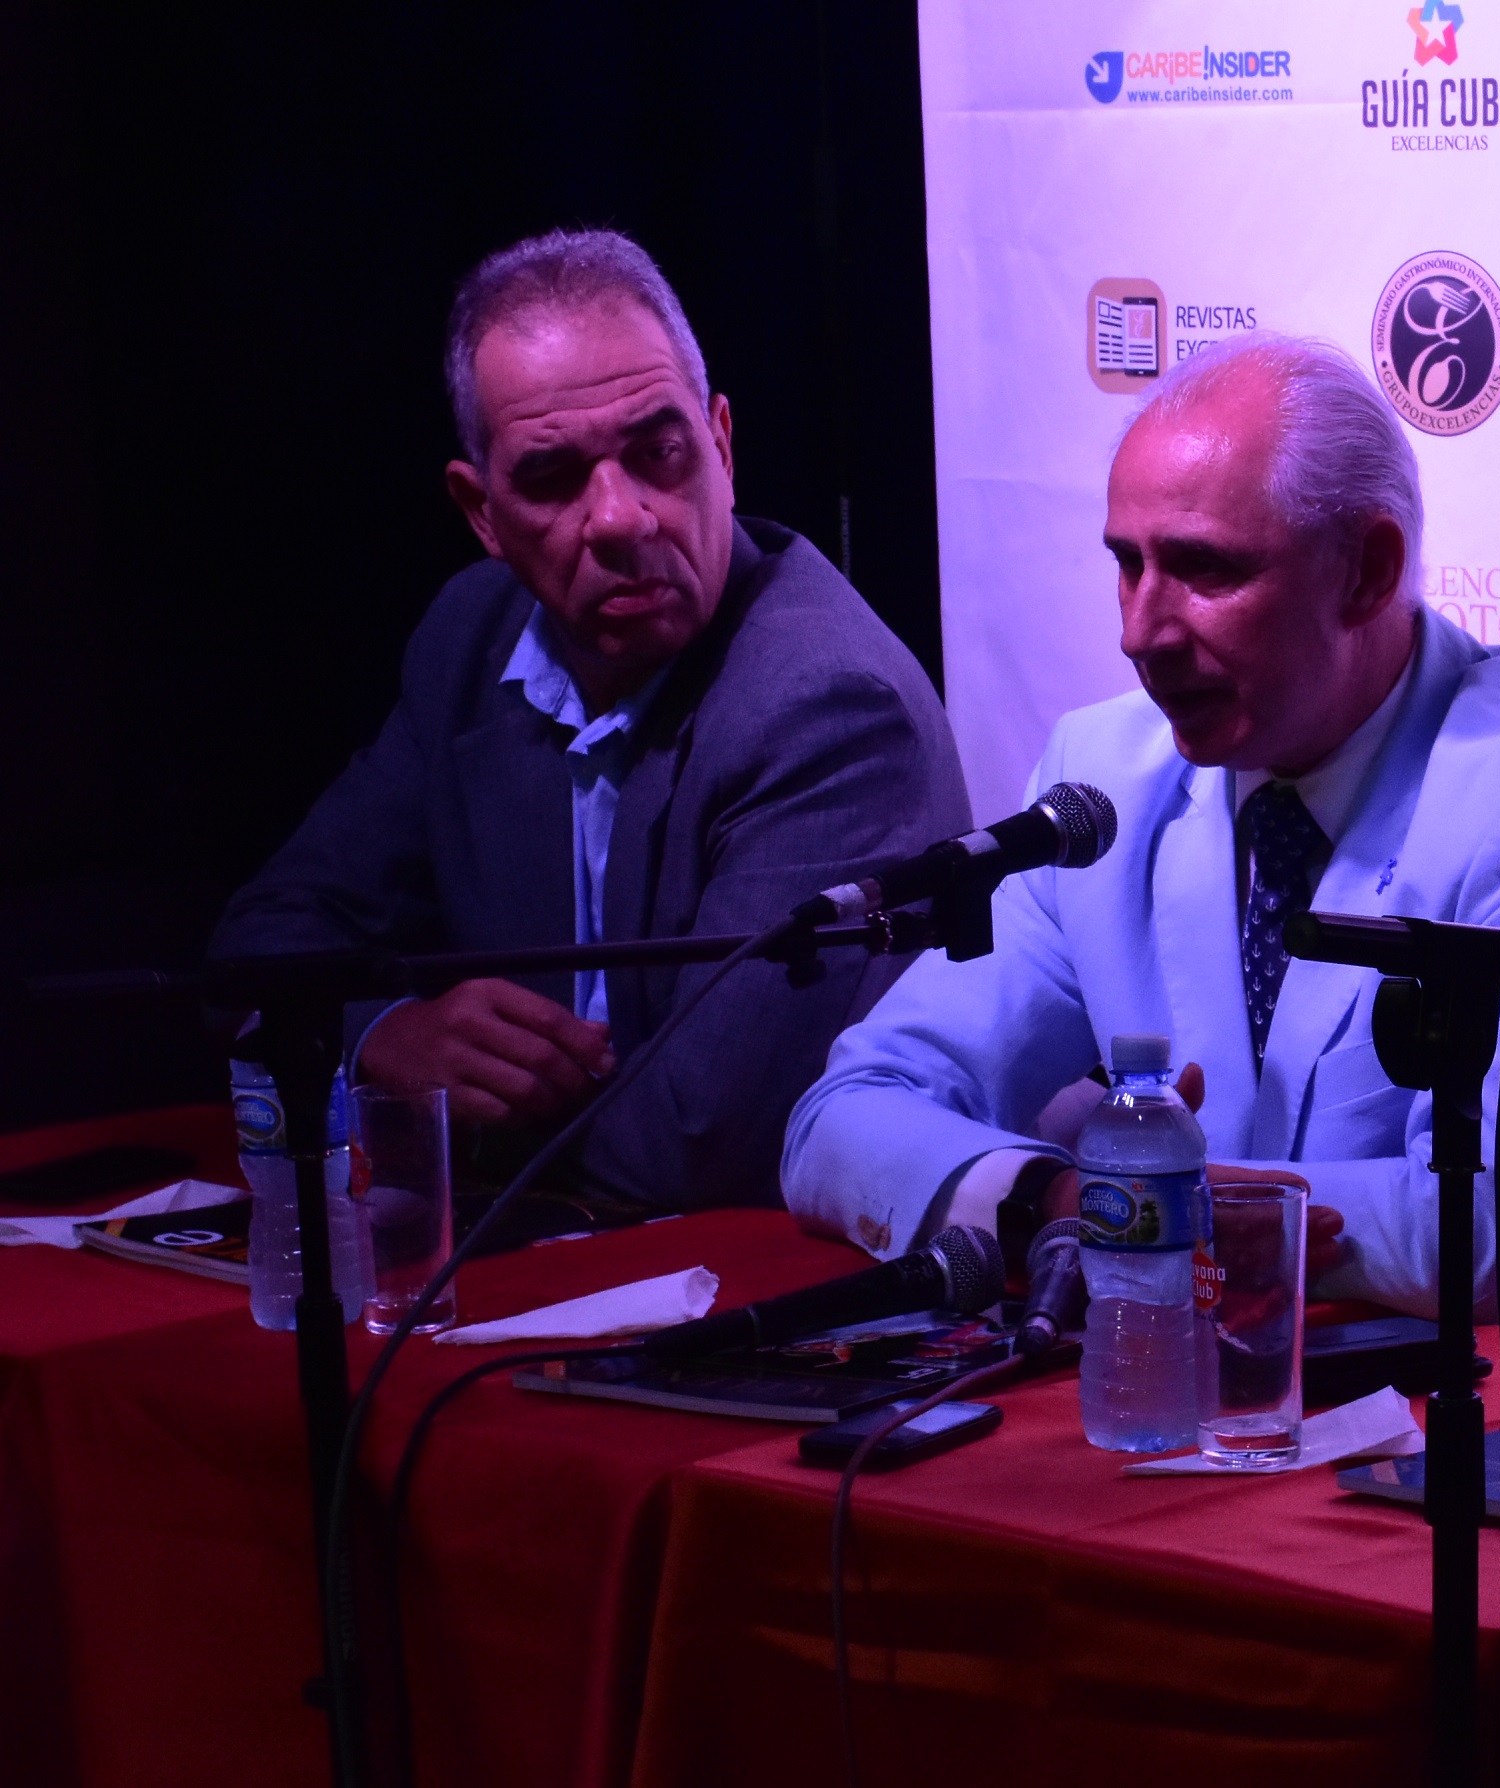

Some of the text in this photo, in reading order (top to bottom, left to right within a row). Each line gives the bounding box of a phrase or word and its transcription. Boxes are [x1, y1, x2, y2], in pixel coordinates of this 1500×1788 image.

[1127, 86, 1293, 103] www.caribeinsider.com
[1361, 69, 1429, 128] GUÍA
[1391, 134, 1489, 152] EXCELENCIAS
[1377, 289, 1397, 352] SEMINARIO
[1394, 257, 1467, 292] GASTRONÓMICO
[1176, 306, 1257, 330] REVISTAS
[1088, 1188, 1114, 1202] CIEGO
[1081, 1196, 1130, 1219] MONTERO
